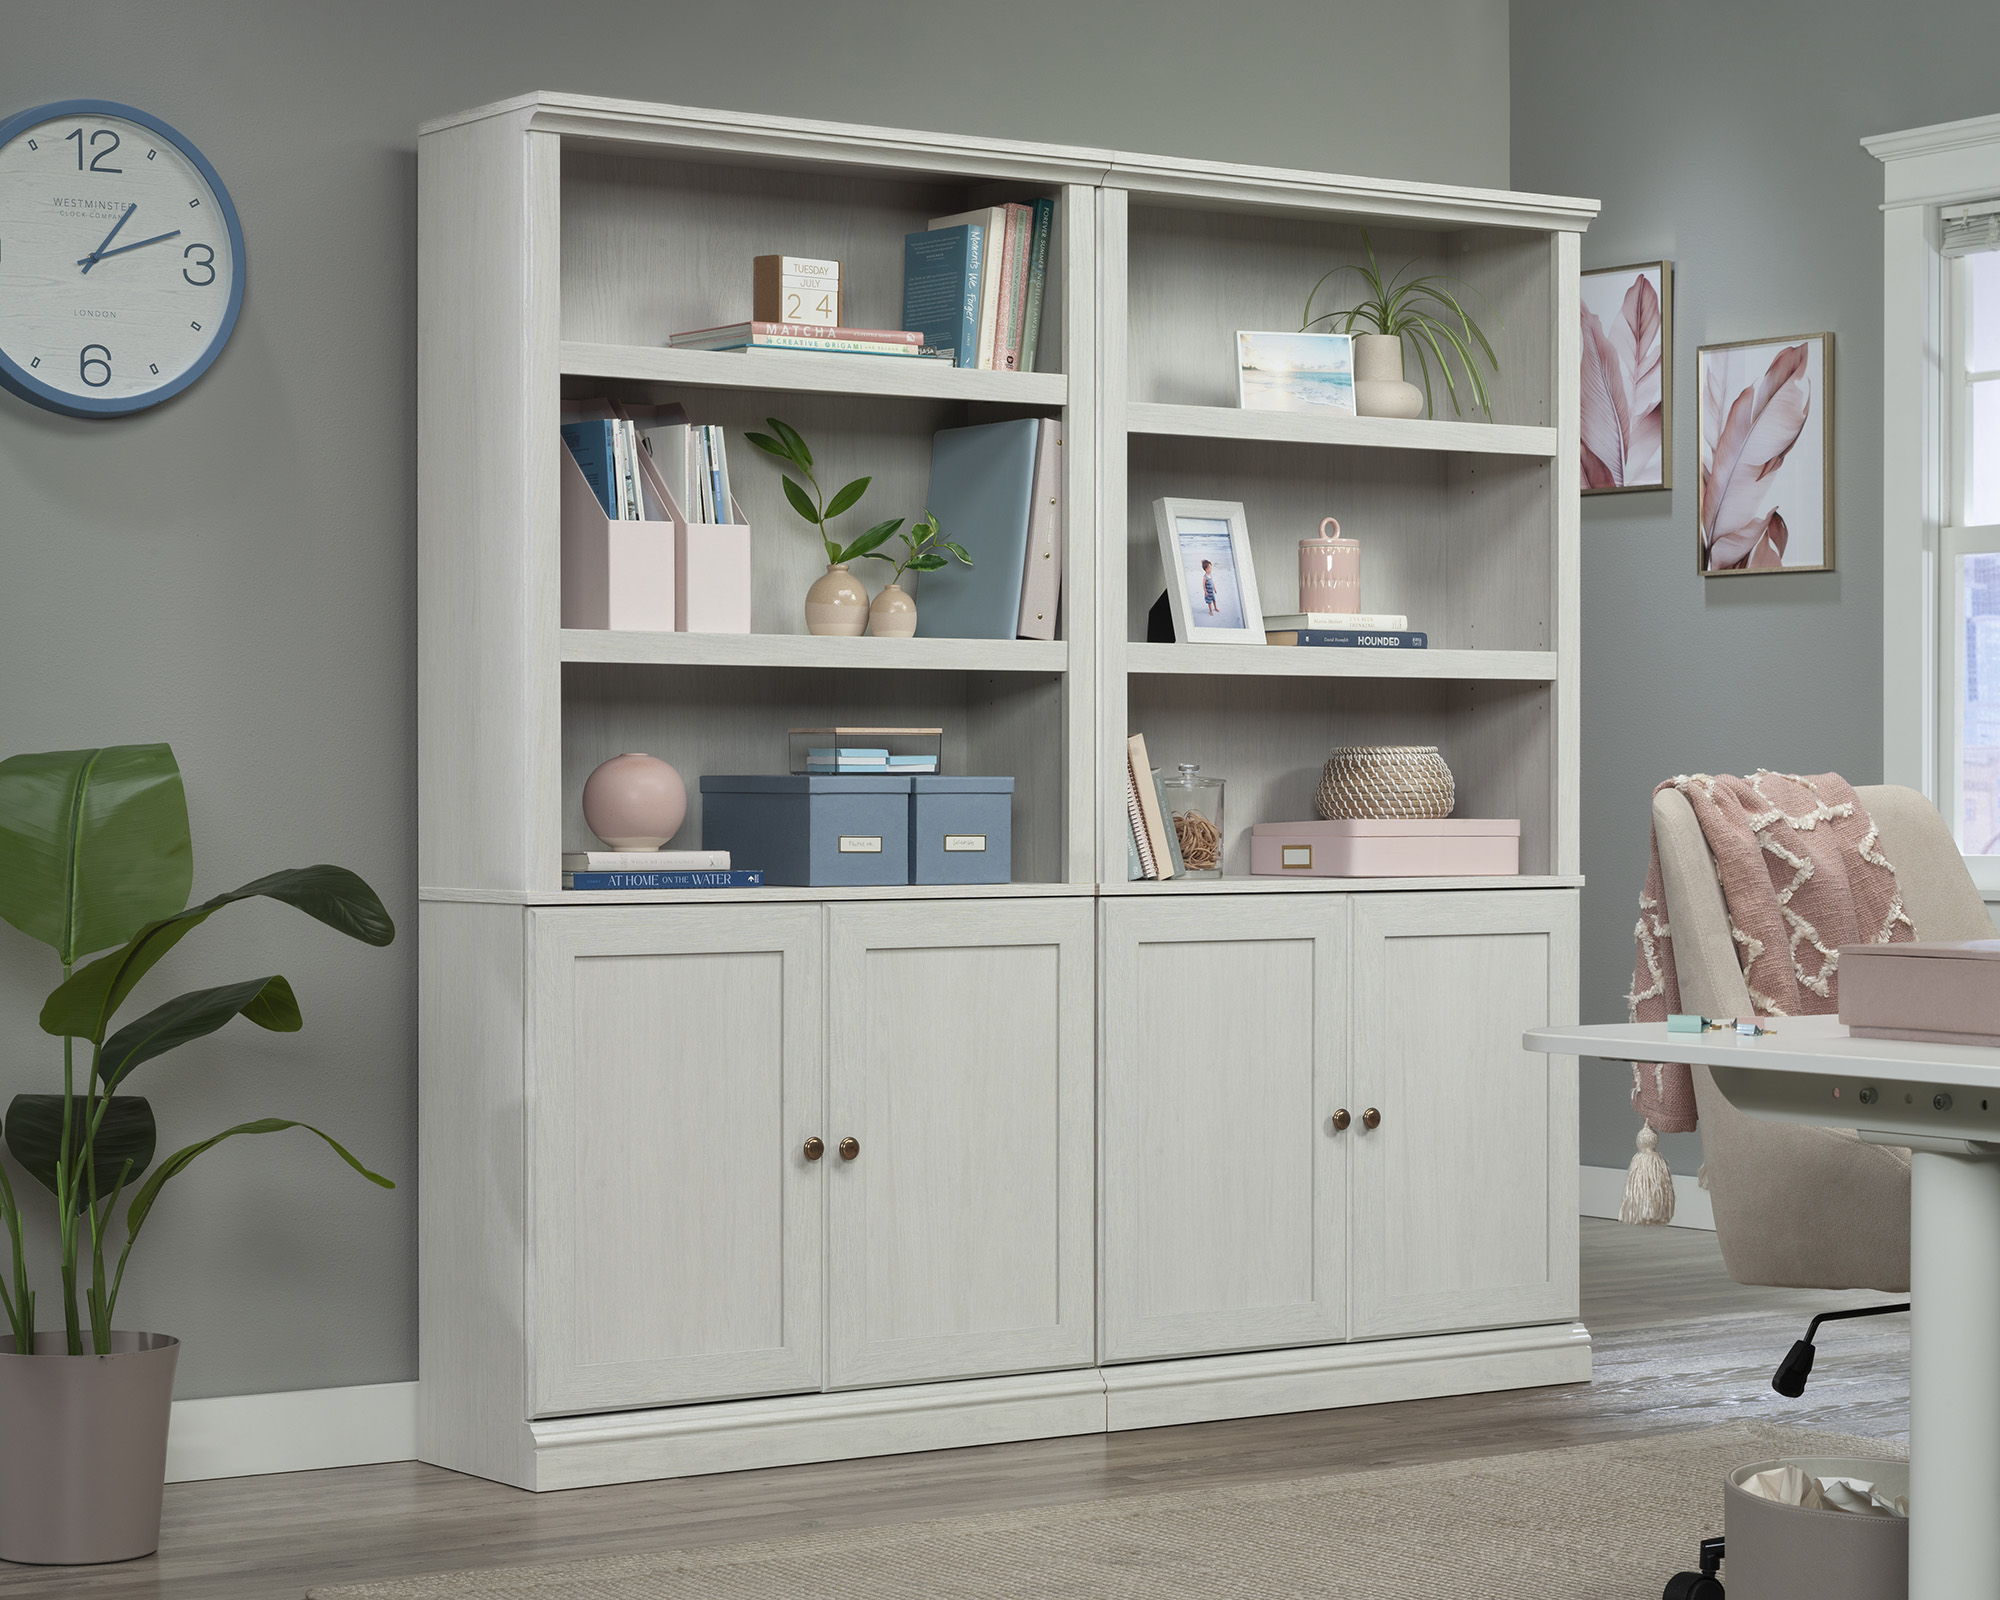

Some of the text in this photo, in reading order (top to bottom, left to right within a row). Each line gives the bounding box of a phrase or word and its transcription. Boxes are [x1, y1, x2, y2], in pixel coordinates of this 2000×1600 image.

[65, 128, 122, 174] 12
[90, 212, 123, 220] COMPAN
[1041, 207, 1050, 238] FOREVER
[182, 243, 216, 286] 3
[793, 263, 829, 275] TUESDAY
[800, 279, 821, 288] JULY
[968, 272, 979, 290] We
[787, 293, 833, 319] 2 4
[963, 293, 977, 325] Forget
[73, 309, 116, 318] LONDON
[766, 324, 837, 338] MATCHA
[777, 338, 818, 347] CREATIVE
[80, 344, 112, 387] 6
[1357, 636, 1400, 647] HOUNDED
[608, 875, 623, 886] AT
[625, 874, 660, 887] HOME
[662, 876, 674, 884] ON
[674, 876, 689, 884] THE
[692, 873, 732, 885] WATER
